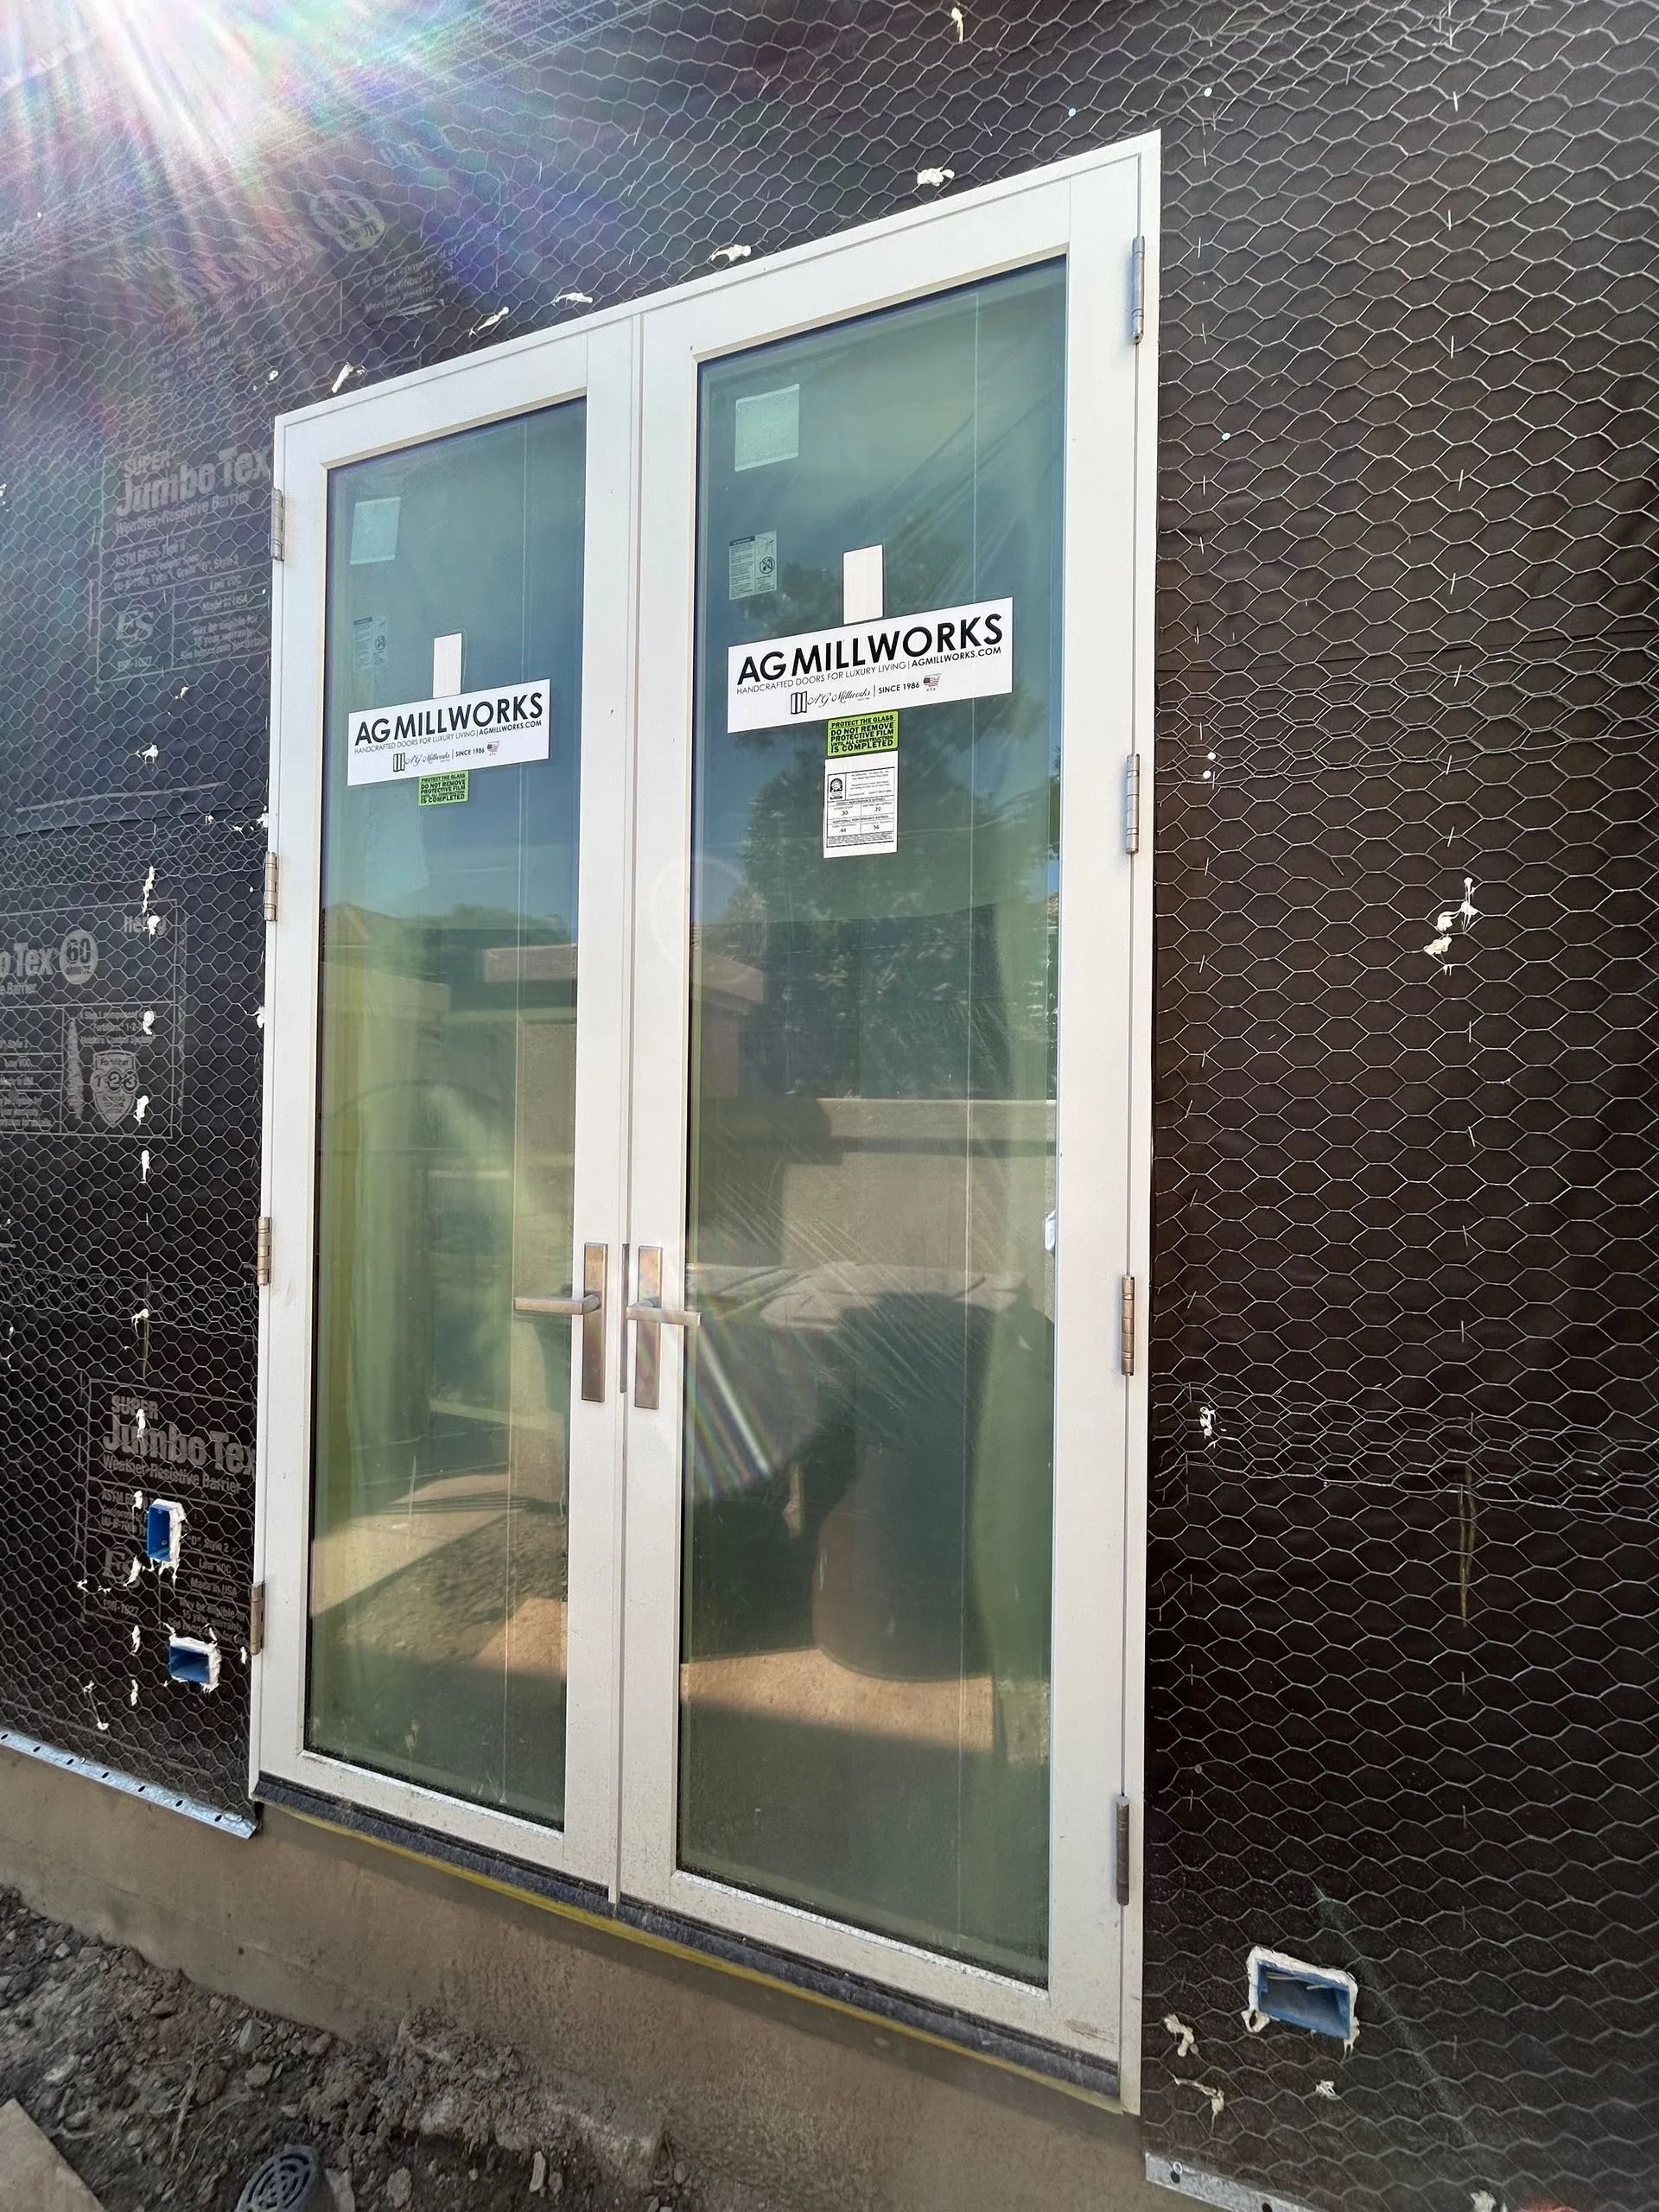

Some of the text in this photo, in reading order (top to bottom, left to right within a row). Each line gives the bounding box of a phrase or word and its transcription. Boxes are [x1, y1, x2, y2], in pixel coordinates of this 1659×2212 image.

[116, 443, 274, 517] Jumbo Tex
[737, 613, 1002, 685] AG MILLWORKS
[736, 680, 793, 695] HANDCRAFTED
[796, 675, 824, 685] DOORS
[827, 672, 843, 681] FOR
[846, 667, 875, 678] LUXURY
[878, 684, 900, 694] SINCE
[354, 692, 543, 746] AG MILLWORKS
[861, 721, 894, 732] REMOVE
[397, 739, 417, 748] DOORS
[432, 734, 454, 743] LUXURY
[831, 732, 874, 742] PROTECTIVE
[842, 740, 893, 752] COMPLETED
[429, 794, 465, 803] COMPLETED
[124, 916, 167, 936] Heny
[13, 942, 54, 977] Tex
[66, 938, 92, 963] 60
[111, 1395, 158, 1420] SUPER
[103, 1414, 257, 1476] Jumbo Tex
[202, 1473, 241, 1494] Barrier
[224, 1543, 229, 1553] 2
[190, 1578, 211, 1589] Made
[220, 1584, 238, 1596] USA
